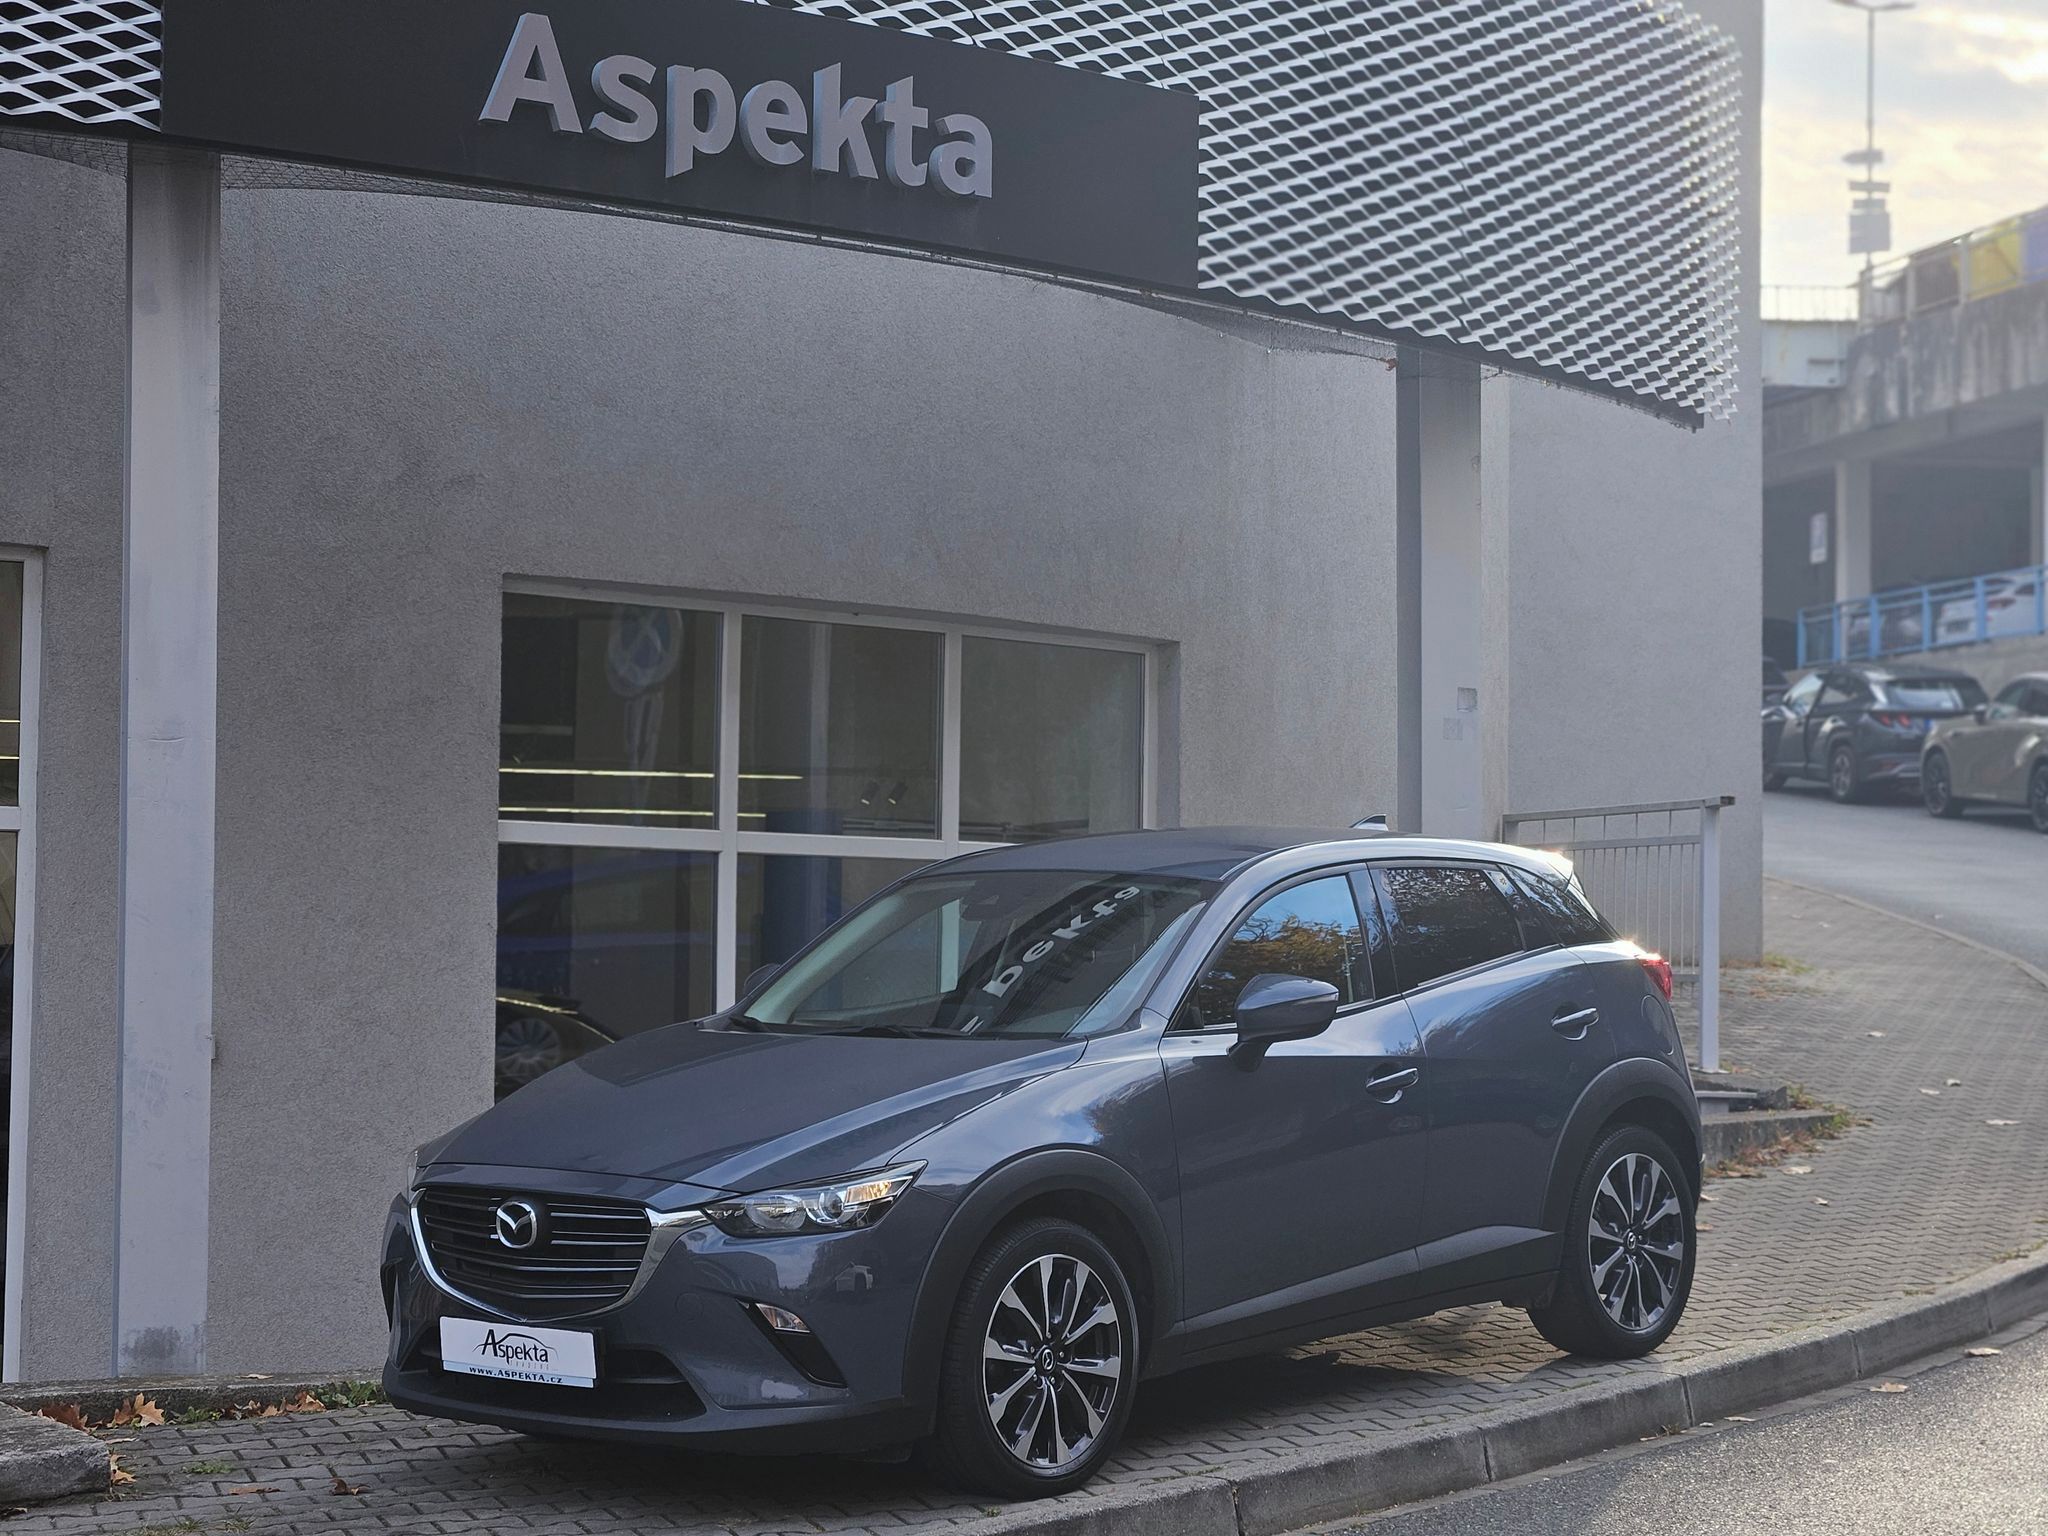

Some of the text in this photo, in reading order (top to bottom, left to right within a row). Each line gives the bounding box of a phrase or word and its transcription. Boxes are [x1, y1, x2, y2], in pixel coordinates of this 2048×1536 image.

[478, 12, 992, 198] Aspekta
[481, 1329, 549, 1365] Aspekta
[469, 1366, 563, 1384] www.ASPEKTA.cz
